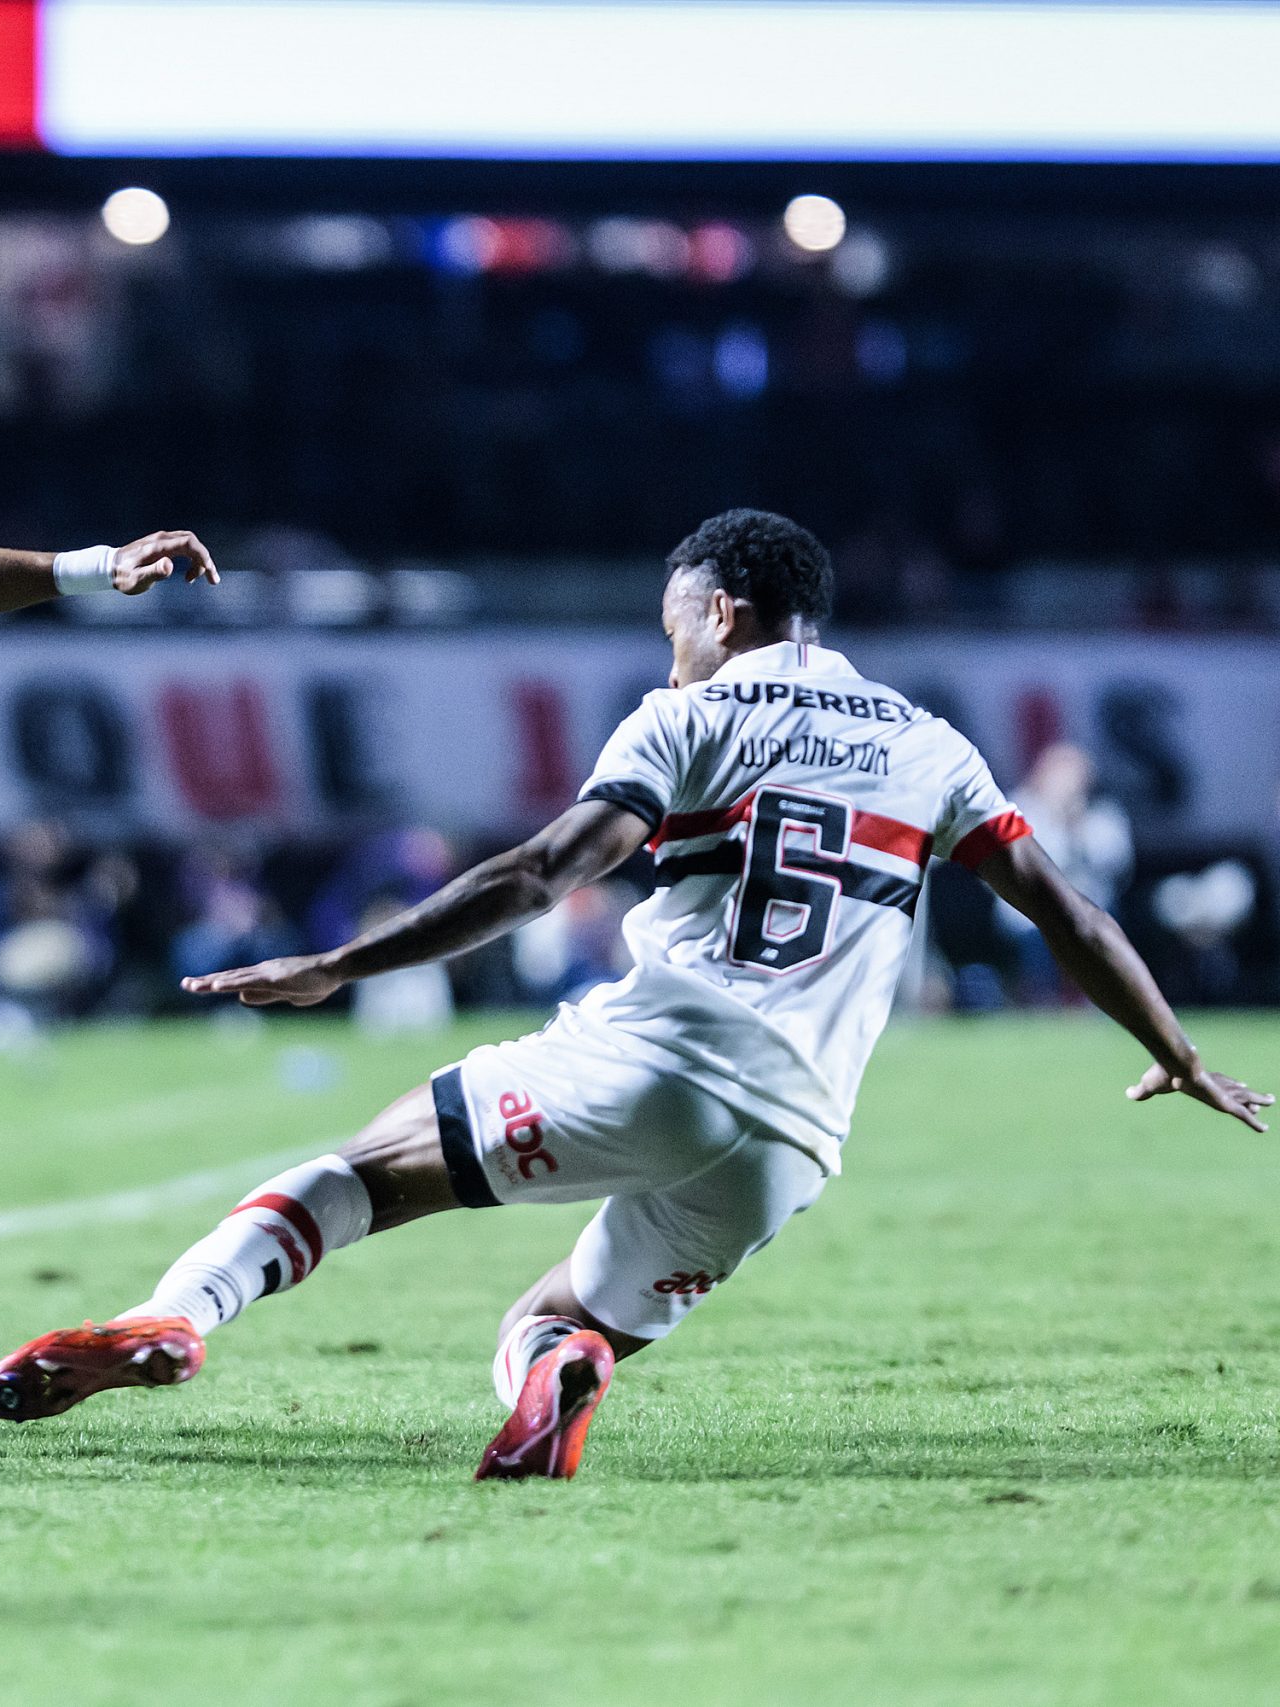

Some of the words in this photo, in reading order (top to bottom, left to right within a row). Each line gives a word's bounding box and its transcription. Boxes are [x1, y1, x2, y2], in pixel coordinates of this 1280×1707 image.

[703, 681, 913, 722] SUPERBET
[727, 784, 854, 977] 6
[499, 1089, 559, 1181] abc
